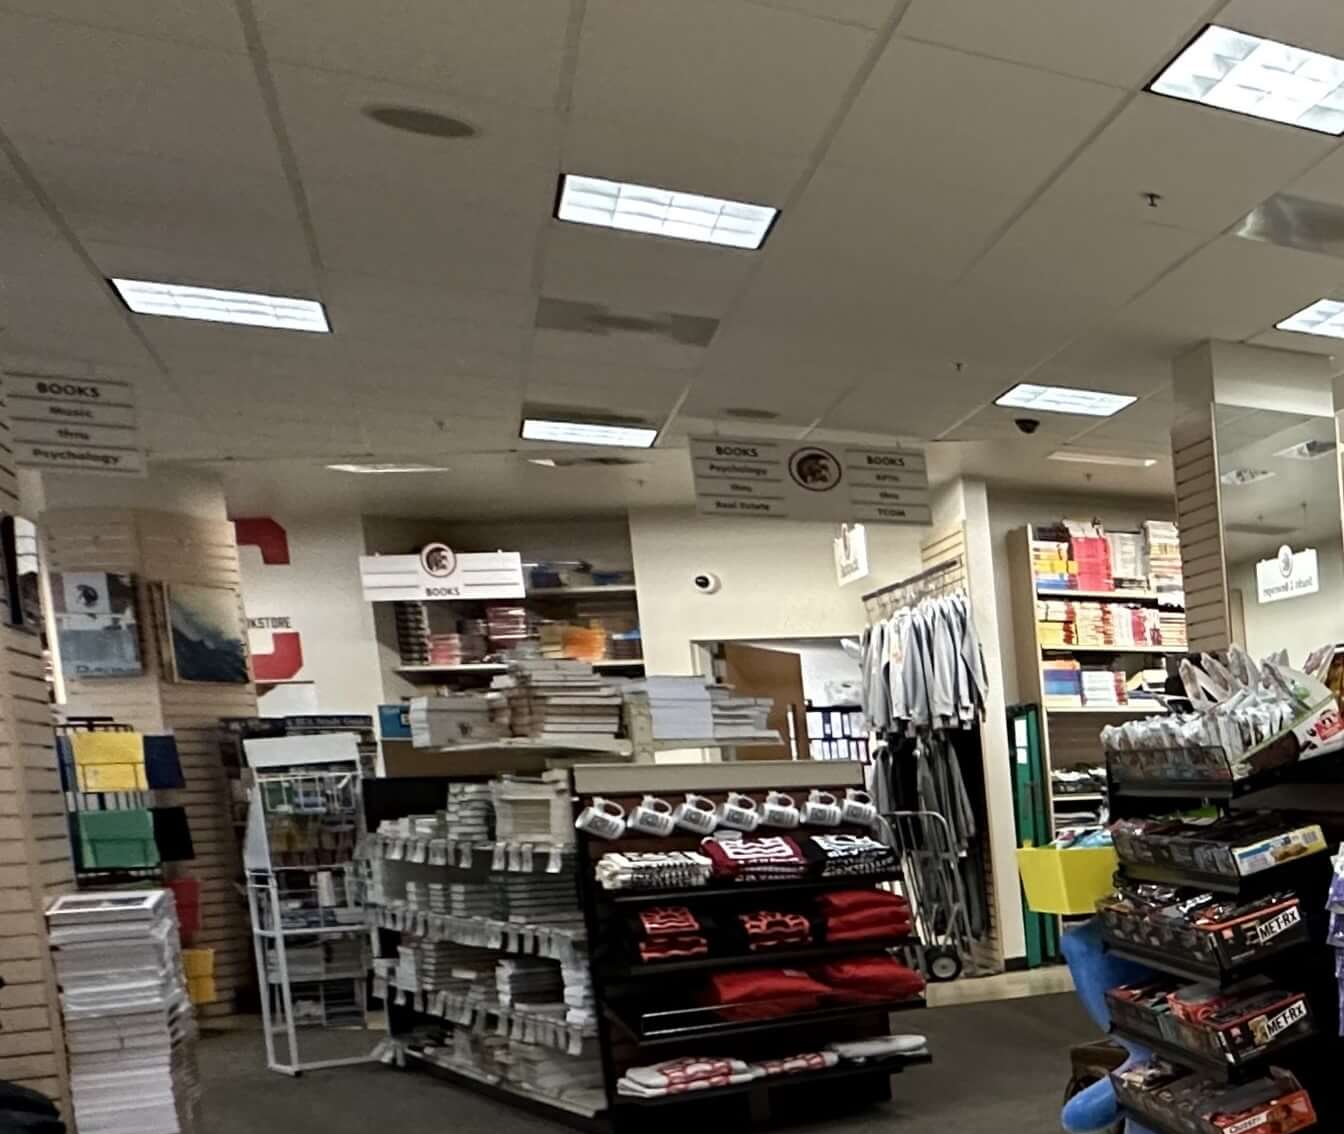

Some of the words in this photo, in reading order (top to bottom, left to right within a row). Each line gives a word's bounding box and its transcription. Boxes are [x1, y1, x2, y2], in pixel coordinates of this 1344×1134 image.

[36, 382, 100, 398] BOOKS
[32, 448, 119, 464] Psychology
[715, 446, 759, 458] BOOKS
[866, 456, 905, 467] BOOKS
[709, 463, 767, 476] Psychology
[715, 501, 737, 510] Real
[740, 501, 770, 512] Estate
[425, 587, 461, 597] BOOKS
